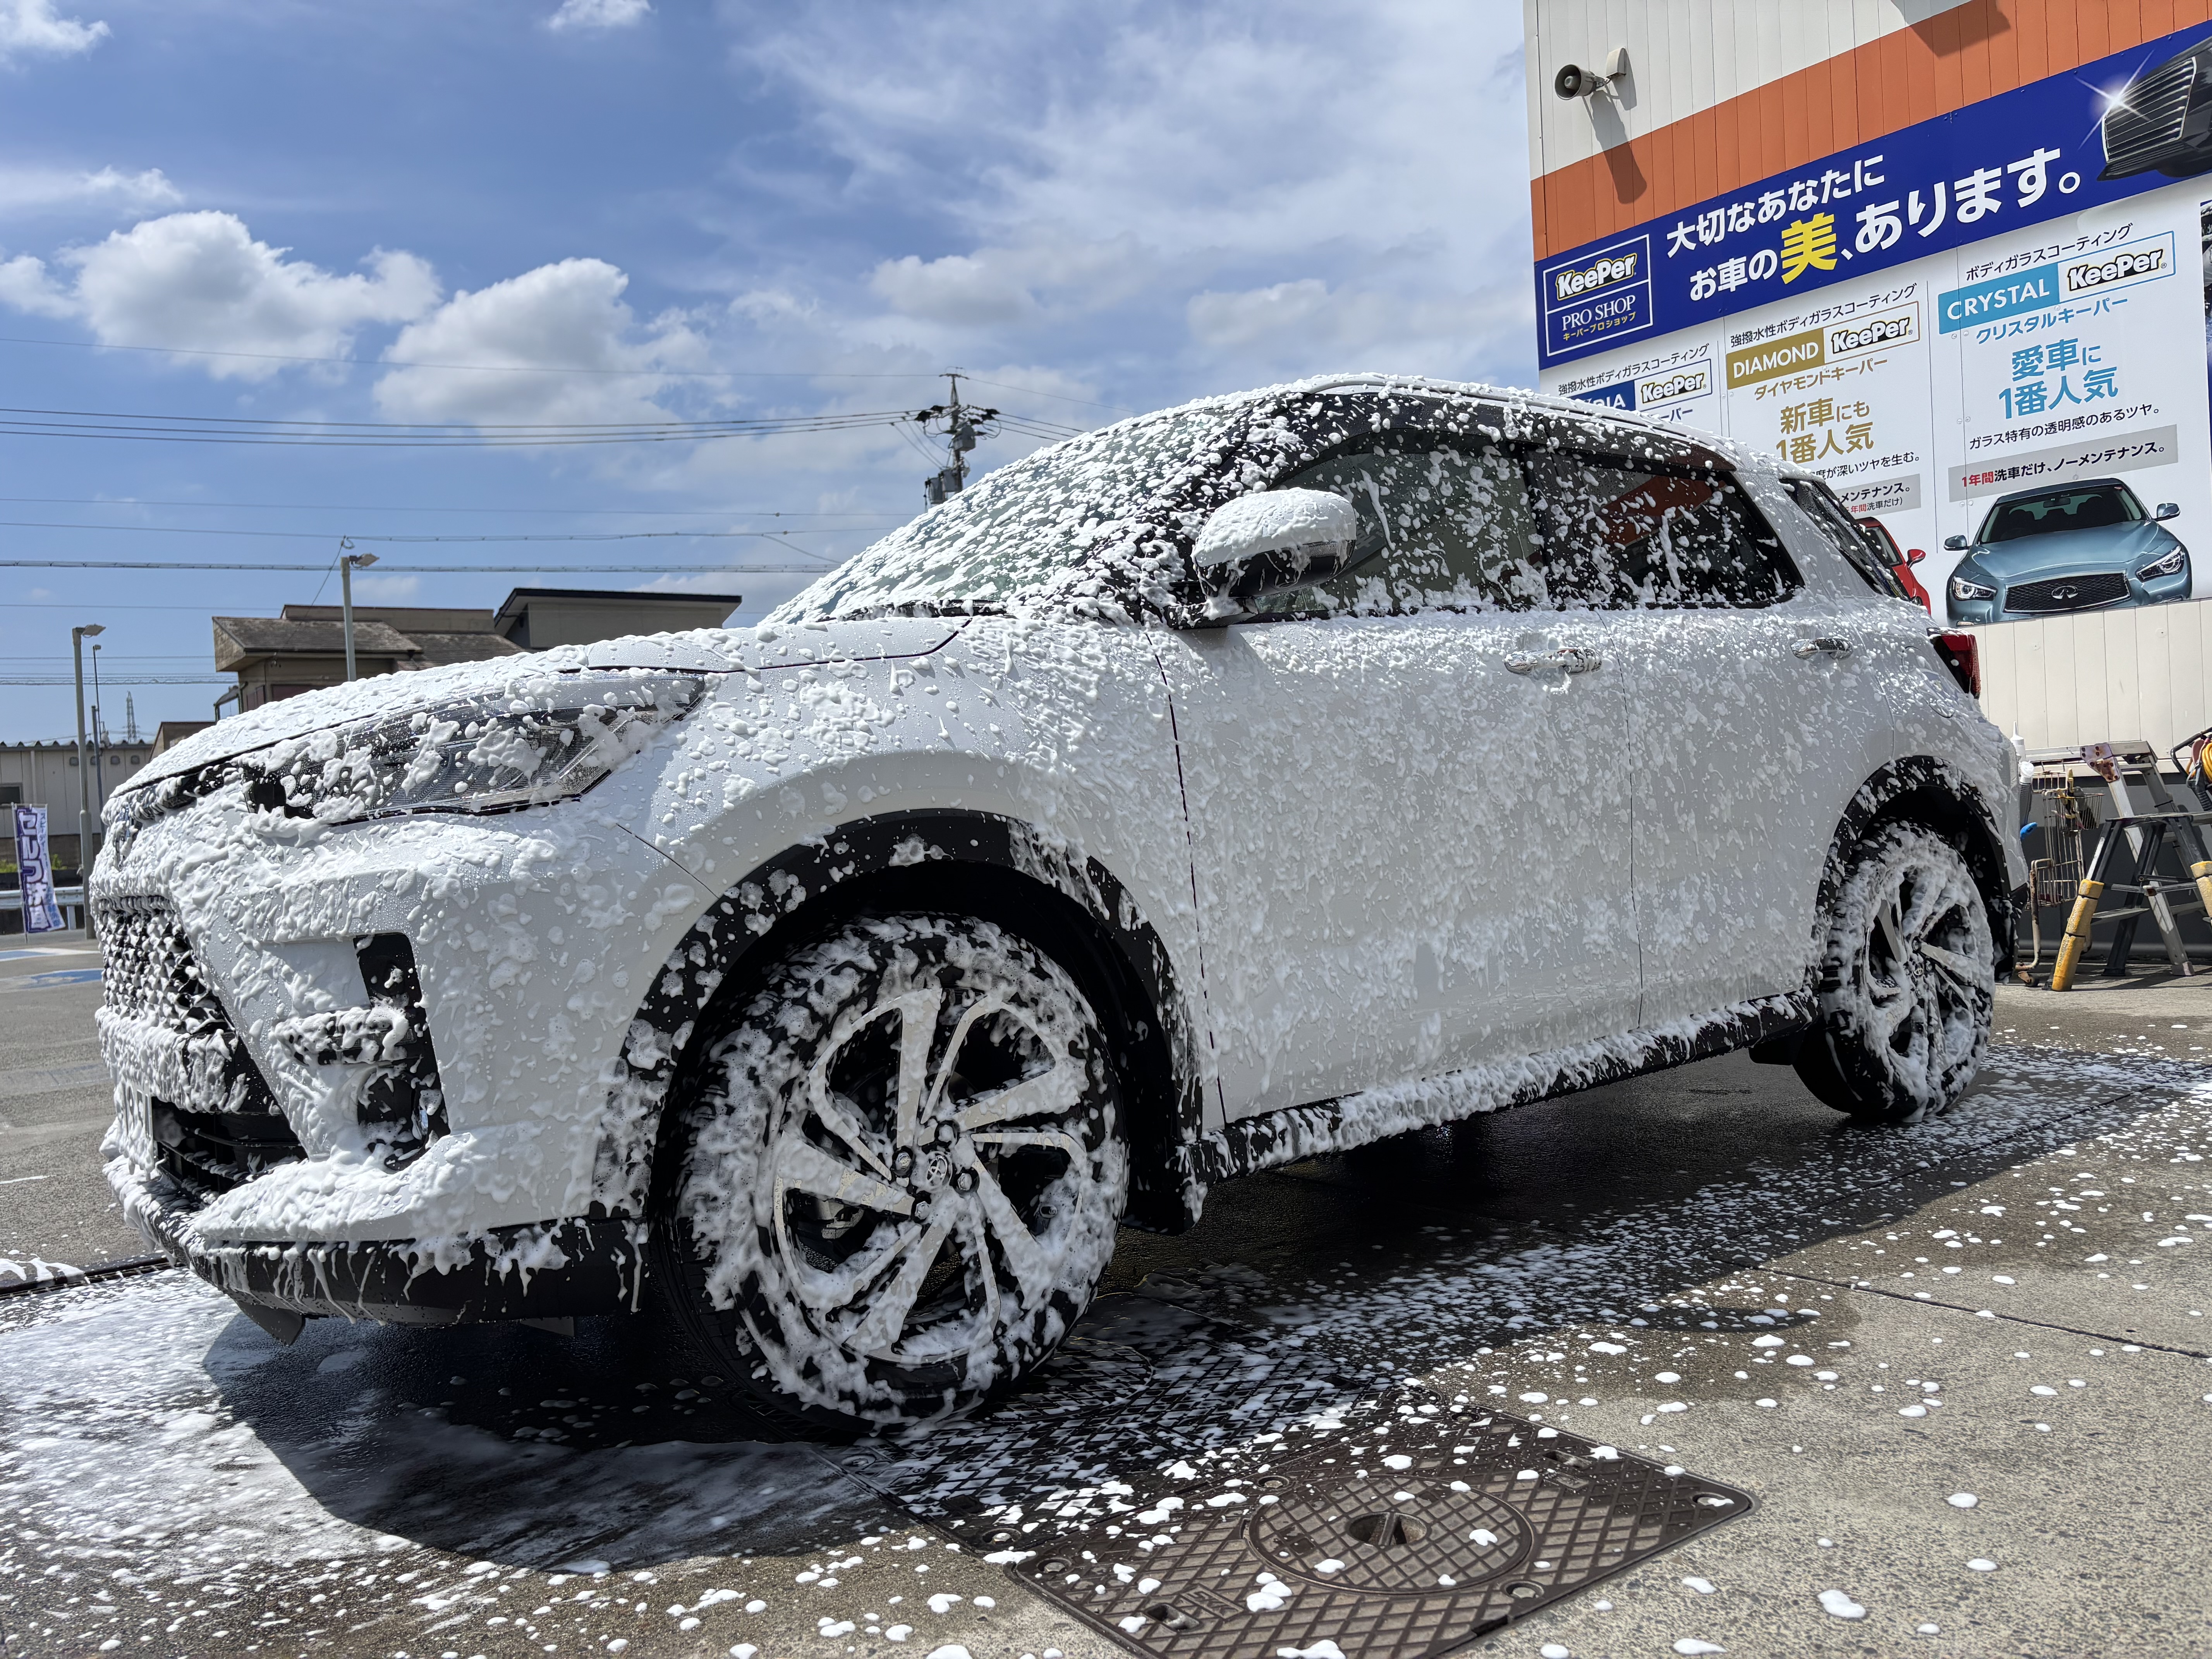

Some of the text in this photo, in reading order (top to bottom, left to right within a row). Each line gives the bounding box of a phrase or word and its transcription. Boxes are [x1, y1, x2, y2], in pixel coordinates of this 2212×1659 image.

[1666, 155, 1884, 258] 大切なあなたに
[1690, 148, 2080, 301] お車の美、あります。
[1966, 223, 2133, 281] ボディガラスコーティング
[1556, 254, 1637, 300] KeePer
[1947, 249, 2164, 320] CRYSTAL KeePer
[1562, 295, 1636, 331] PRO SHOP
[1563, 312, 1636, 341] キーパープロショップ
[1730, 283, 1917, 348] 強撥水性ボディガラスコーティング
[1976, 298, 2128, 344] クリスタルキーパー
[1558, 344, 1709, 396] 強撥水性ボディガラスコーティング
[1733, 316, 1910, 378] DIAMOND KeePer
[2012, 338, 2102, 382] 愛車に
[1641, 373, 1704, 404] KeePer
[1754, 358, 1887, 400] ダイヤモンドキーパー
[1998, 367, 2118, 419] 1番人気
[1780, 398, 1870, 434] 新車にも
[1970, 404, 2159, 450] ガラス特有の透明感のあるツヤ。
[1776, 422, 1874, 464] 1番人気
[1812, 452, 1919, 480] 度が深いツヤを生む。
[1961, 441, 2165, 487] 1年間洗車だけ、ノーメンテナンス。
[1838, 483, 1910, 503] メンテナンス。
